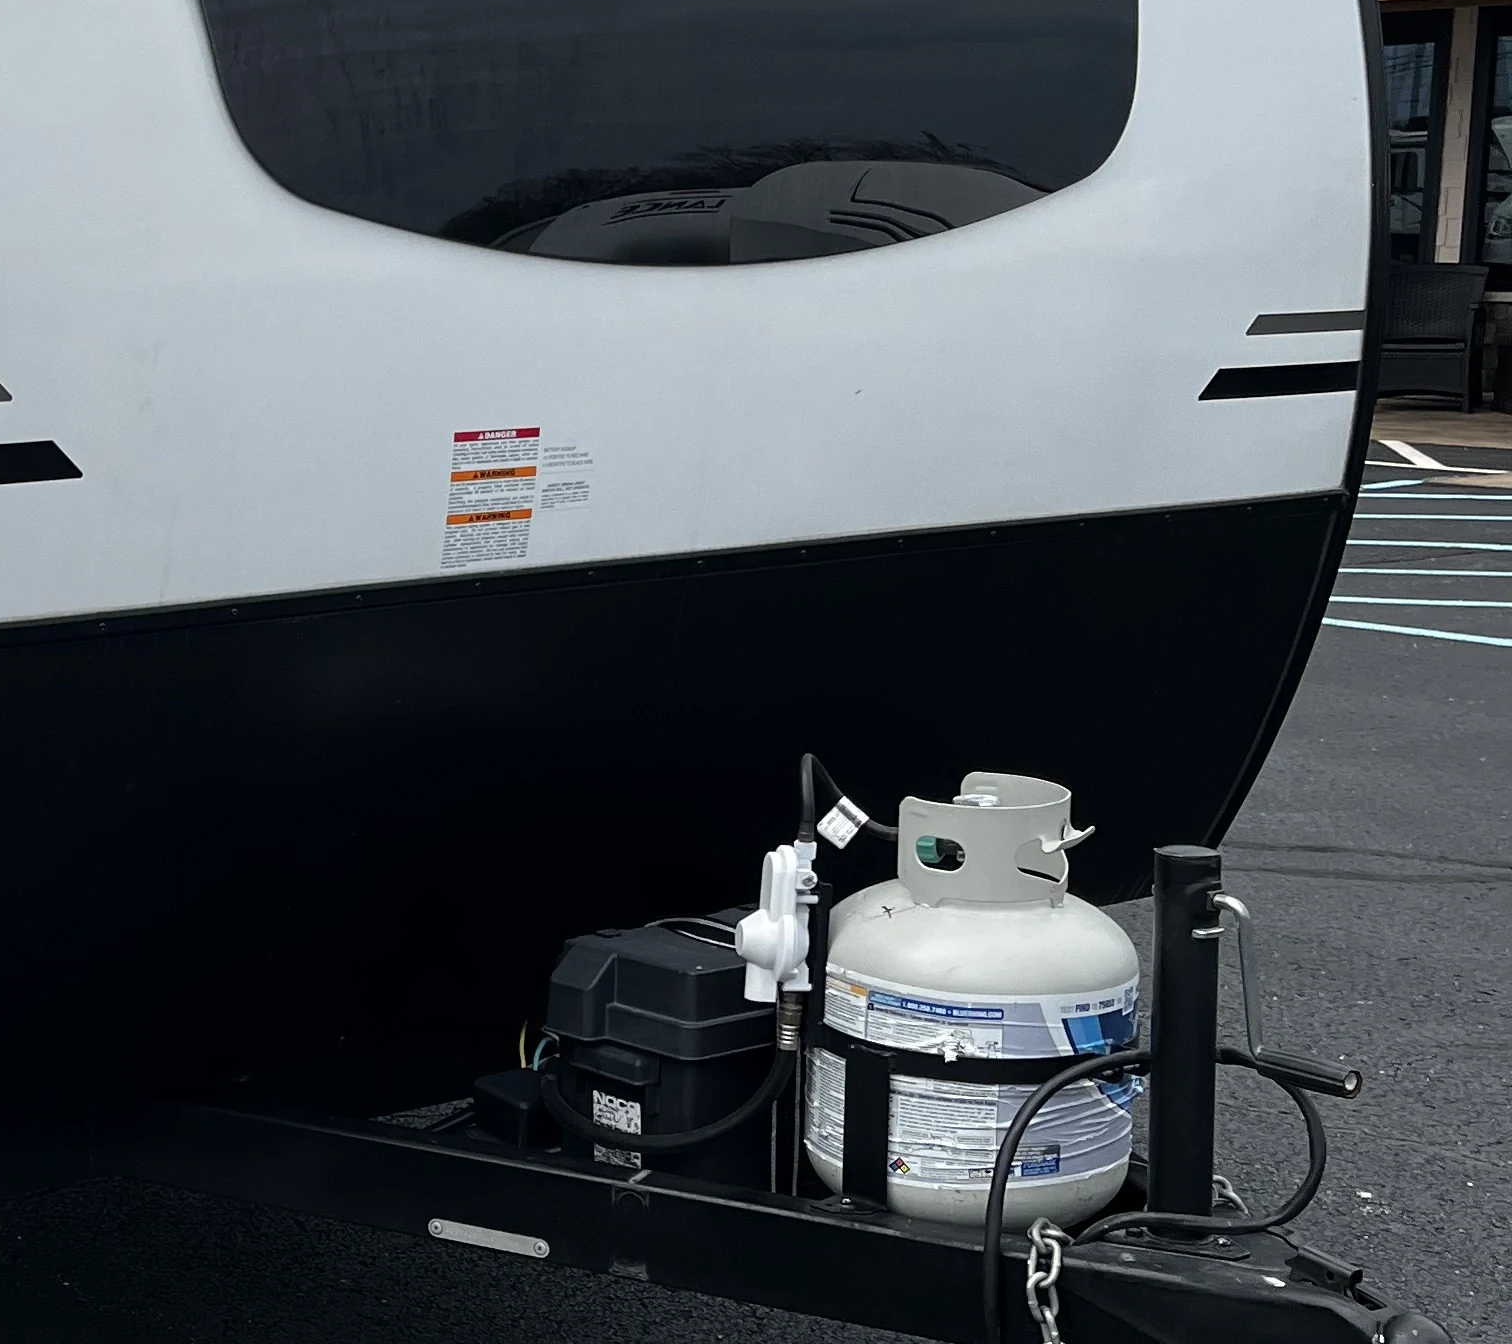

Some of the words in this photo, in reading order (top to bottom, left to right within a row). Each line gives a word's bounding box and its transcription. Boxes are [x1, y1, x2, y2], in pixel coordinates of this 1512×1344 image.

[484, 430, 517, 440] DANGER
[479, 469, 516, 478] WARNING
[475, 512, 511, 521] WARNING
